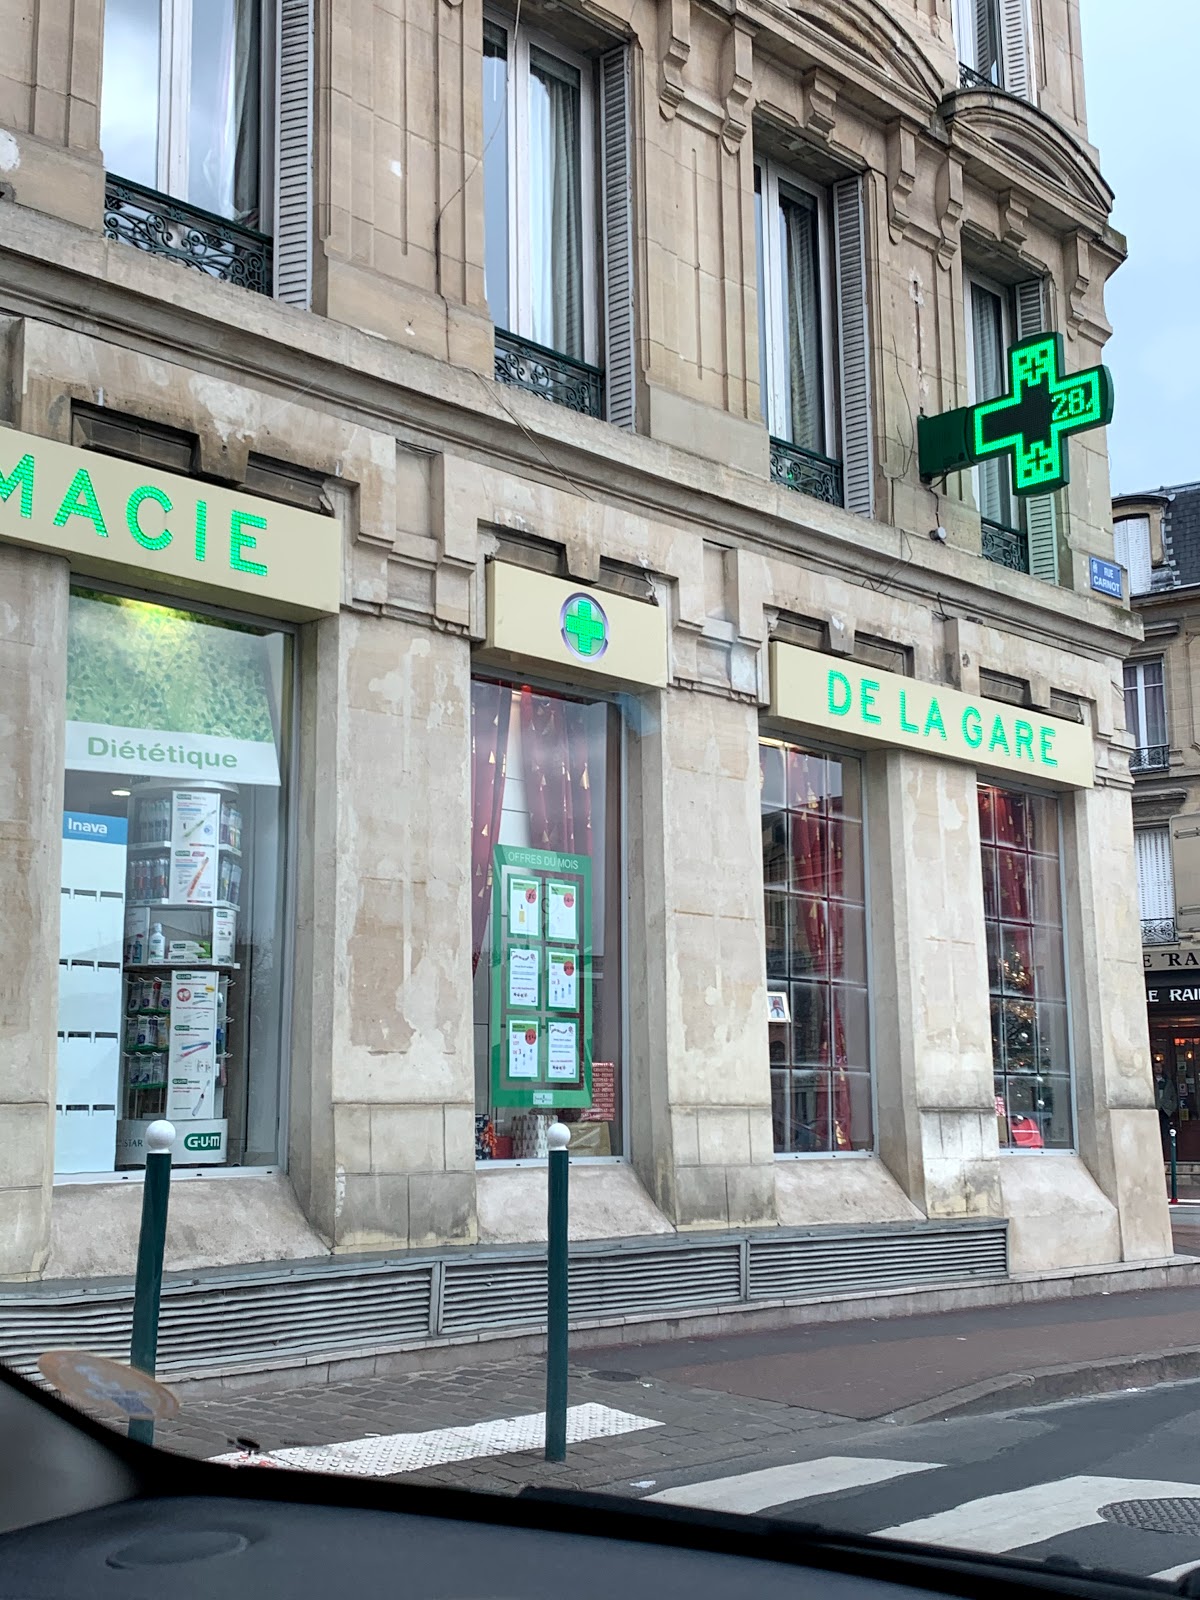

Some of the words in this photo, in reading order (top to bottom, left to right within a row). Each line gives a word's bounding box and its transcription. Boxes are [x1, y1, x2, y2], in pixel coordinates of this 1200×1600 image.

[1103, 567, 1114, 578] RUE
[1093, 575, 1120, 593] CARNOT
[827, 669, 881, 724] DE
[900, 690, 947, 739] LA
[961, 705, 1058, 766] GARE
[87, 737, 238, 769] Diététique
[68, 818, 108, 834] Inava
[508, 851, 542, 865] OFFRES
[544, 855, 556, 867] DU
[558, 857, 579, 870] MOIS
[1169, 988, 1200, 1001] RAI
